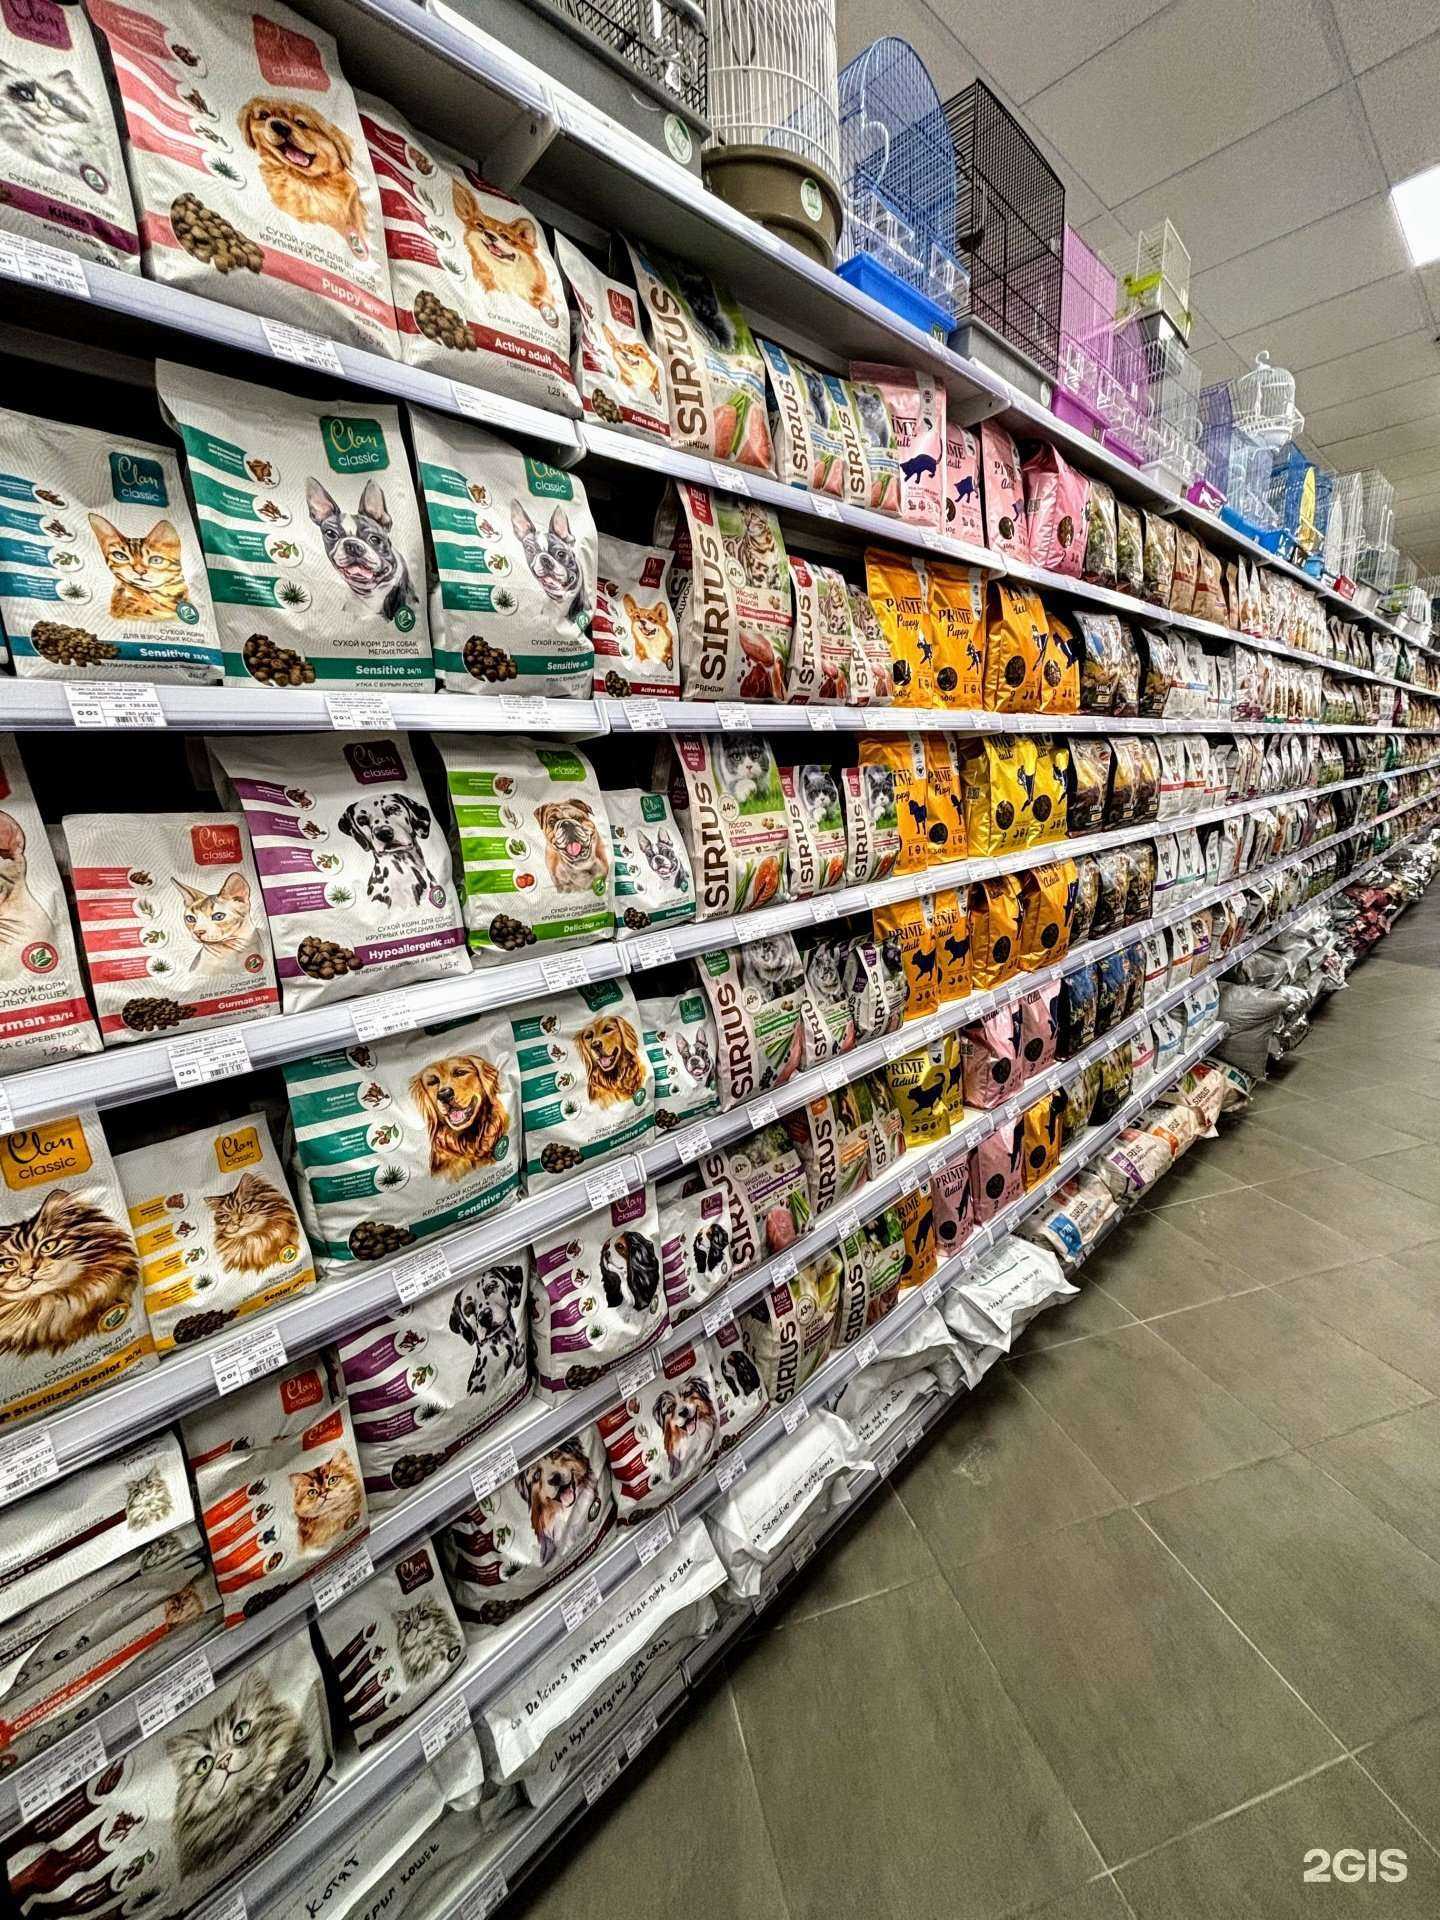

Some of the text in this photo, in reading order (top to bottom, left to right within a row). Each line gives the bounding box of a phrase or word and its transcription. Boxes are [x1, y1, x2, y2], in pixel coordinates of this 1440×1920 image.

[266, 226, 298, 244] СУХОЙ
[322, 278, 361, 307] Puppy
[495, 338, 552, 364] Active adult
[650, 289, 708, 437] SIRIUS
[631, 414, 647, 425] Active
[779, 378, 809, 478] SIRIUS
[330, 419, 377, 452] Clan
[338, 452, 380, 467] classic
[839, 410, 866, 502] SIRIUS
[118, 456, 159, 489] Clan
[121, 488, 160, 501] classic
[535, 481, 567, 495] classic
[699, 534, 730, 682] SIRIUS
[886, 596, 922, 615] PRIME
[938, 606, 973, 624] PRIME
[896, 613, 920, 630] Puppy
[947, 623, 970, 640] Puppy
[333, 639, 360, 648] СУХОЙ
[361, 640, 381, 648] КОРМ
[396, 640, 418, 649] СОБАК
[798, 593, 816, 686] SIRIUS
[140, 648, 191, 660] Sensitive
[356, 664, 405, 676] Sensitive
[547, 661, 580, 671] Sensitive
[641, 686, 656, 694] Active
[694, 683, 725, 694] PREMIUM
[354, 743, 397, 769] Clan
[362, 766, 400, 779] classic
[728, 821, 753, 829] ЛОСОСЬ
[199, 827, 237, 850] Clan
[695, 780, 730, 908] SIRIUS
[789, 804, 813, 883] SIRIUS
[854, 803, 869, 878] SIRIUS
[202, 849, 236, 861] classic
[378, 923, 400, 932] СУХОЙ
[888, 920, 925, 941] PRIME
[369, 938, 442, 960] Hypoallergenic
[31, 990, 69, 1002] КОШЕК
[38, 981, 66, 992] КОРМ
[218, 997, 254, 1010] Gurman
[25, 1028, 81, 1045] КРЕВЕТКОЙ
[717, 982, 754, 1100] SIRIUS
[883, 1060, 925, 1075] PRIME
[892, 1074, 919, 1088] Adult
[7, 1130, 75, 1166] Clan
[221, 1135, 254, 1158] Clan
[19, 1155, 78, 1180] classic
[226, 1151, 256, 1167] classic
[815, 1118, 836, 1214] SIRIUS
[935, 1162, 969, 1188] PRIME
[457, 1192, 501, 1219] Sensitive
[617, 1207, 641, 1222] classic
[264, 1285, 292, 1302] Senior
[845, 1263, 864, 1343] SIRIUS
[44, 1357, 81, 1379] СУХОЙ
[113, 1327, 134, 1346] ДЛЯ
[101, 1333, 137, 1358] КОШЕК
[669, 1358, 693, 1373] classic
[776, 1320, 798, 1403] SIRIUS
[15, 1359, 121, 1417] Sterilized/Senior
[401, 1557, 428, 1582] Clan
[524, 1673, 568, 1716] Delicious
[14, 1690, 67, 1731] Delicious
[550, 1746, 568, 1772] Clan
[400, 1843, 440, 1885] КОШЕК
[305, 1856, 360, 1919] КОТЯТ
